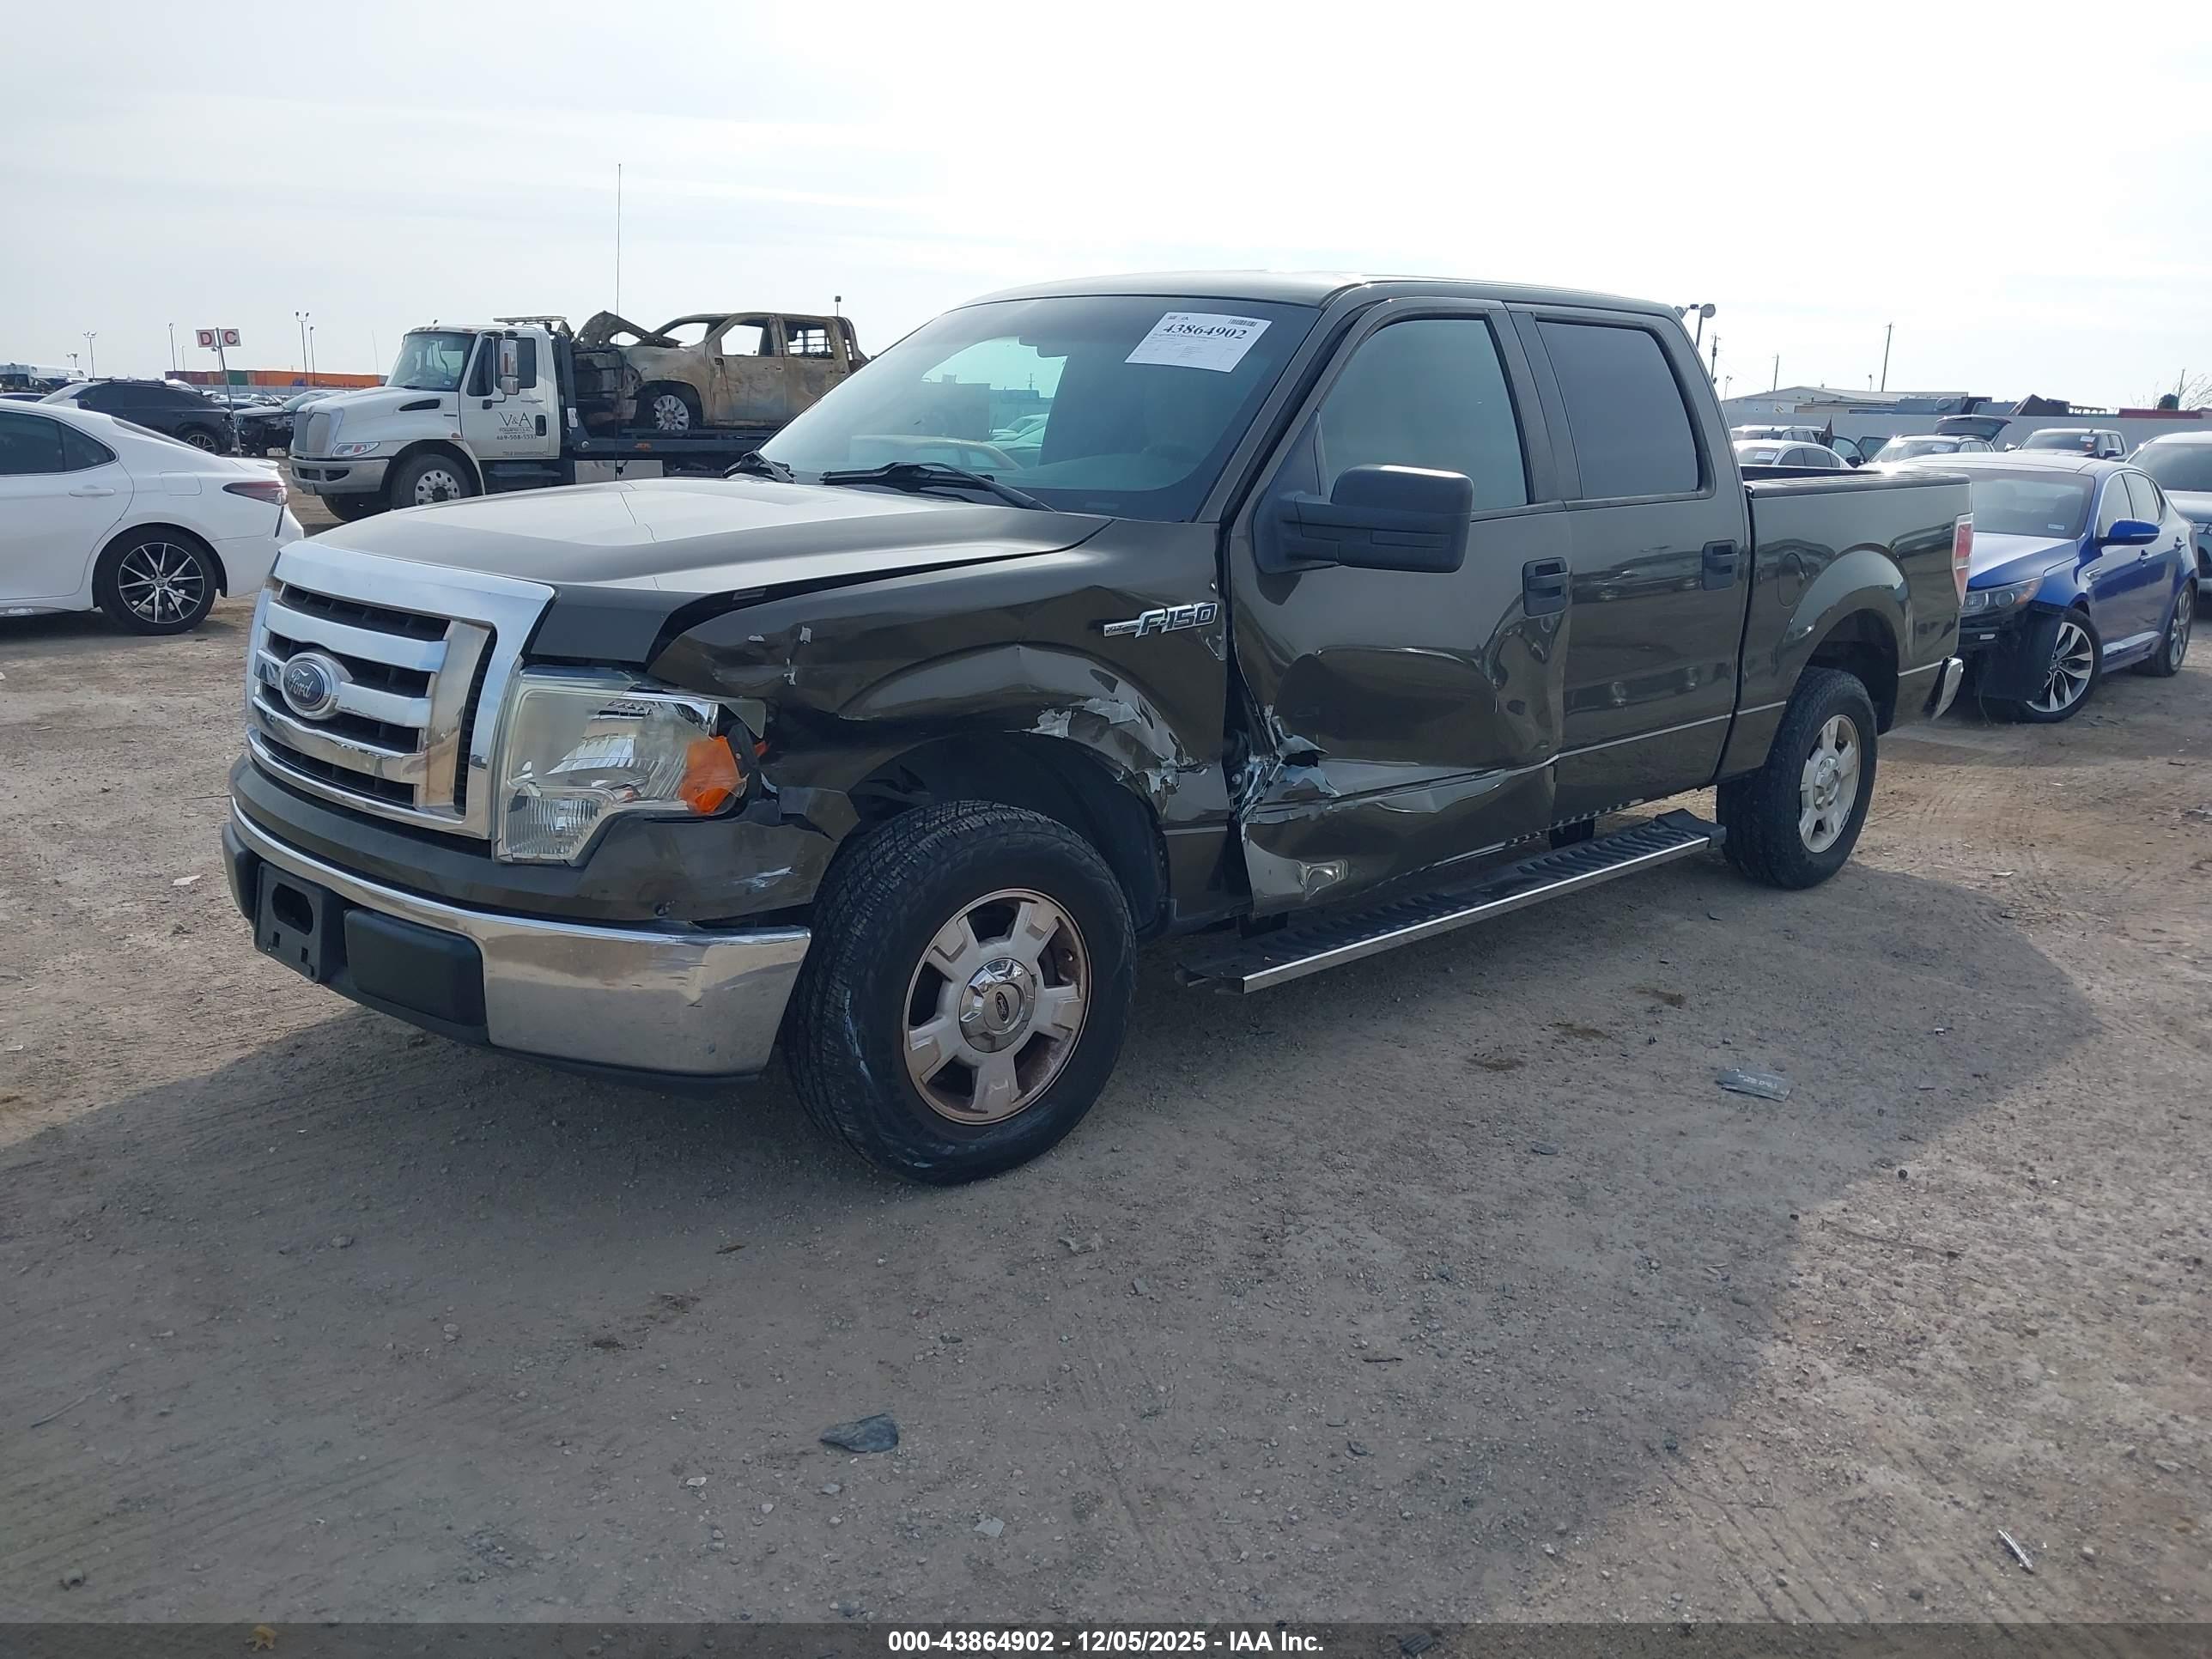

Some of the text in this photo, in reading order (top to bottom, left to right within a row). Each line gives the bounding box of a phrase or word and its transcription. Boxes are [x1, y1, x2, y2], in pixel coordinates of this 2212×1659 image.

[198, 331, 213, 345] D
[224, 331, 237, 344] C
[1163, 323, 1247, 339] 43864902
[498, 411, 534, 430] V&A
[287, 667, 314, 699] Ford
